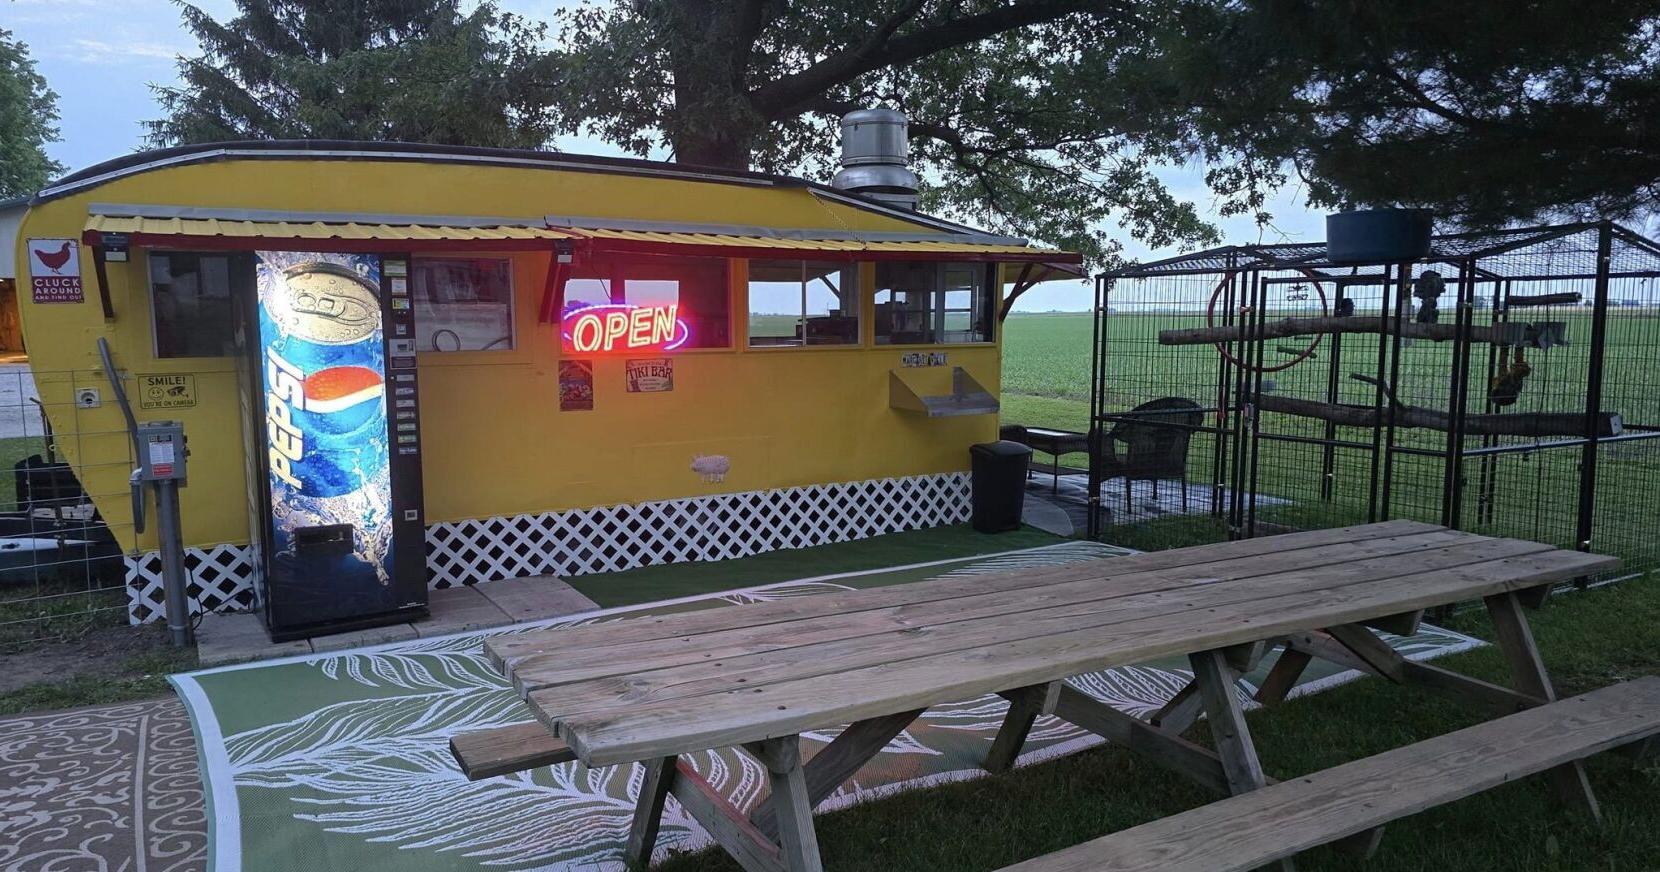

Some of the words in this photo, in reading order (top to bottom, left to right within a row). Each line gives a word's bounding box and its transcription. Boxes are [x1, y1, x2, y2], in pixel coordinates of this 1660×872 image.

[34, 278, 79, 287] CLUCK
[573, 304, 677, 351] OPEN
[626, 366, 649, 380] TIKI
[651, 365, 673, 380] BAR
[148, 376, 186, 386] SMILE!
[267, 345, 304, 490] PEPSI
